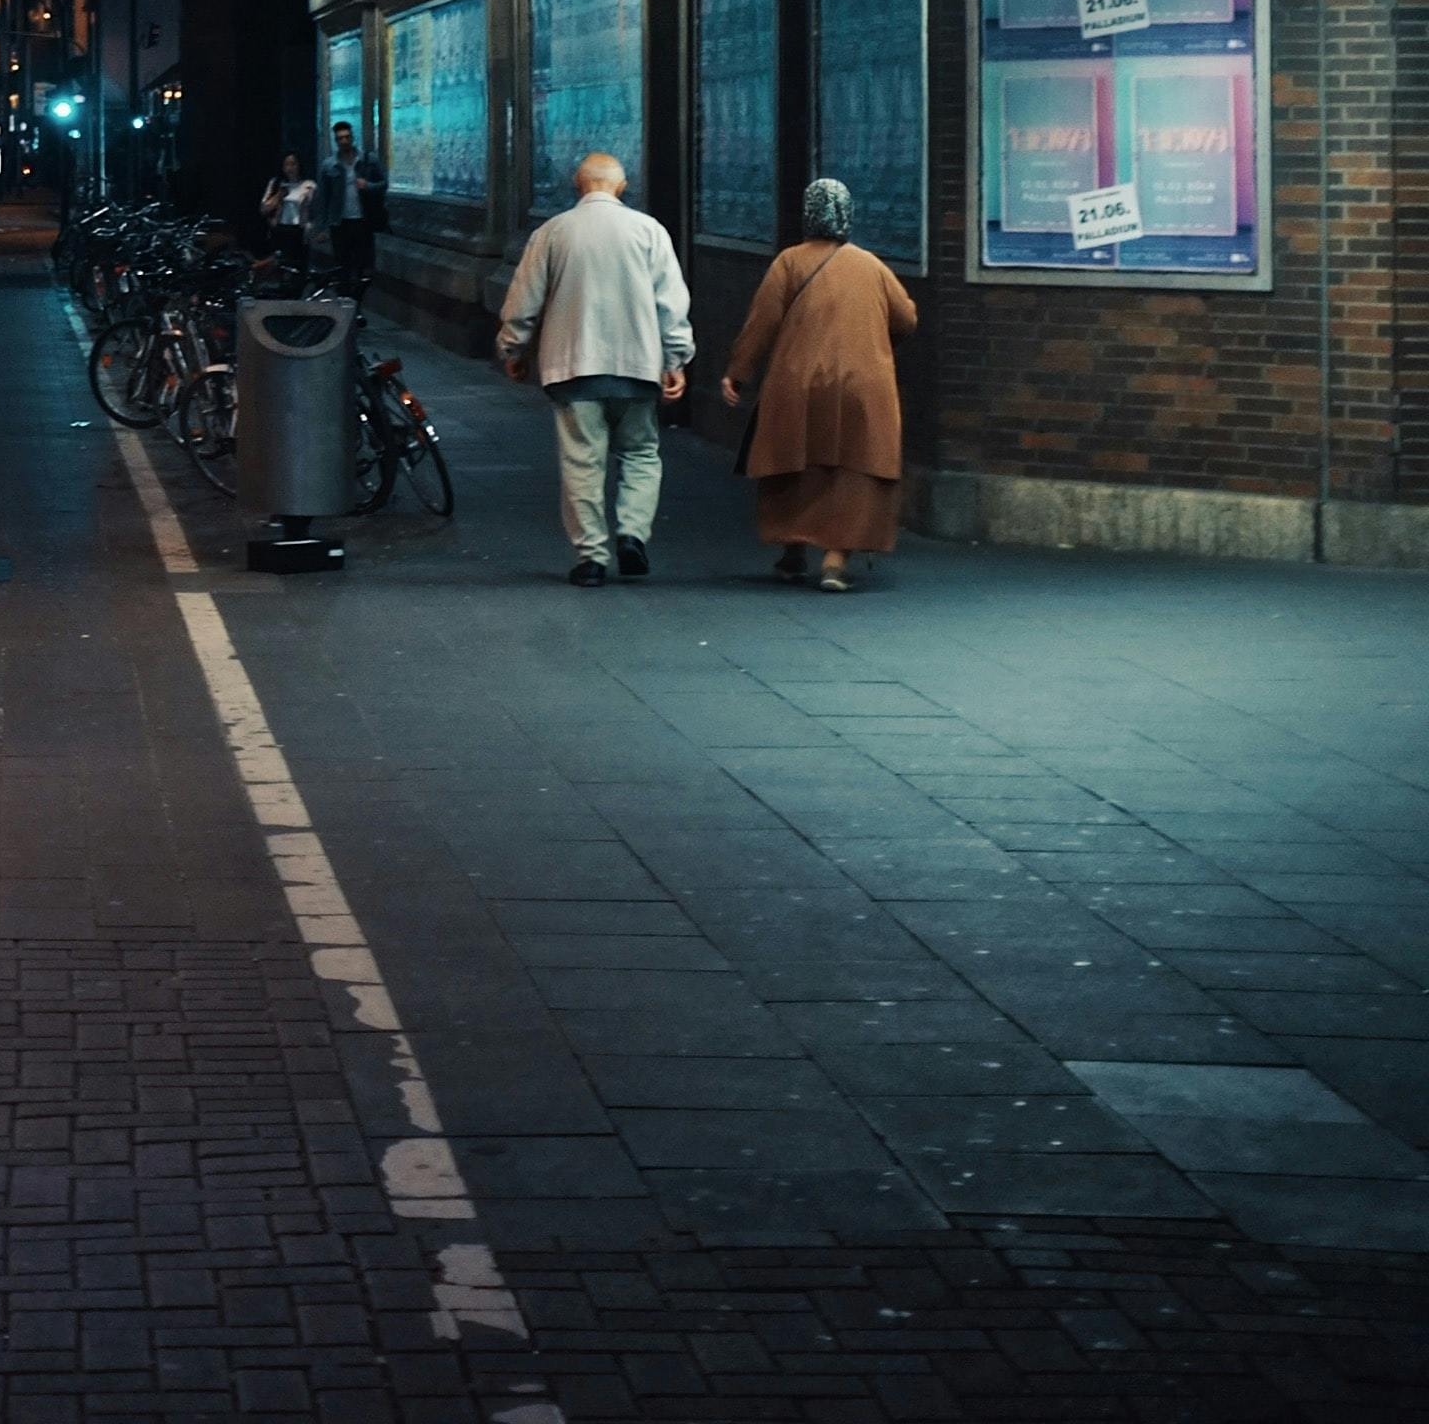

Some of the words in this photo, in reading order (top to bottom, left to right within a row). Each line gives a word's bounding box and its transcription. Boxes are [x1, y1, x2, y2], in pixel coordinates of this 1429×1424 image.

[1084, 13, 1146, 31] PALLADIUM
[1078, 202, 1132, 225] 21.06.
[1077, 223, 1139, 242] PALLADIUM
